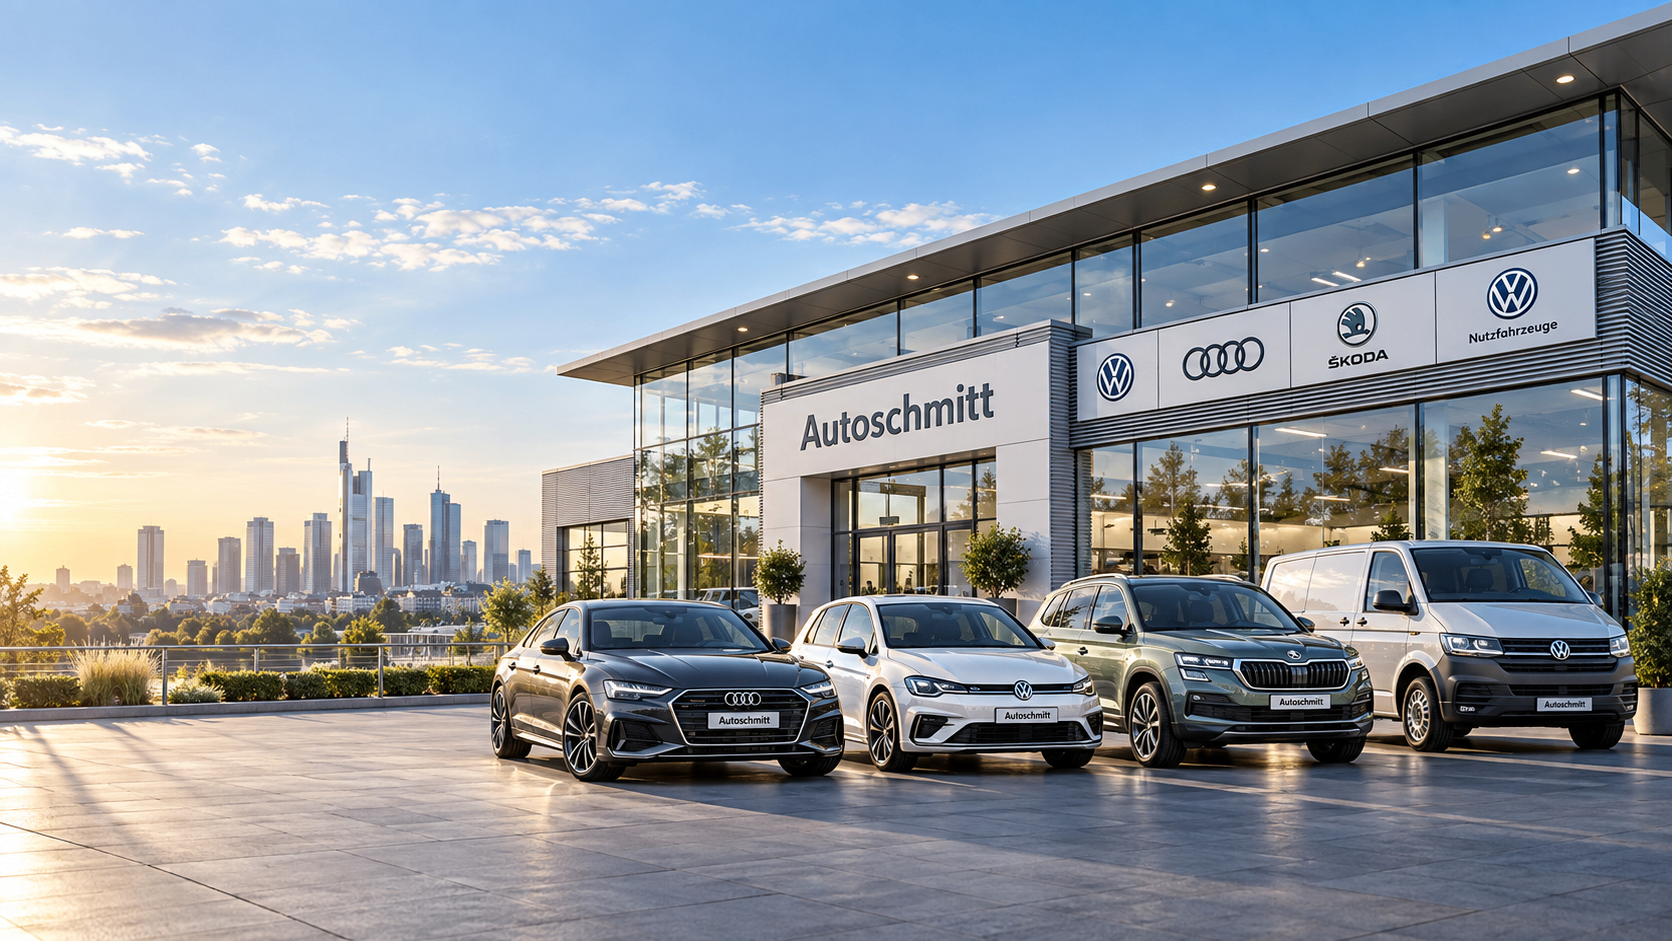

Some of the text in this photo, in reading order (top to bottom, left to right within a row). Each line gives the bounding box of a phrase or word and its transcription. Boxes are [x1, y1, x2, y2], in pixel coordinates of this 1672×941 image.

[1468, 320, 1558, 344] Nutzfahrzeuge
[1328, 348, 1389, 369] ŠKODA
[801, 383, 994, 450] Autoschmitt
[1279, 697, 1324, 706] Autoschmitt
[1544, 700, 1586, 709] Autoschmitt
[718, 715, 771, 725] Autoschmitt
[1004, 711, 1051, 720] Autoschmitt
